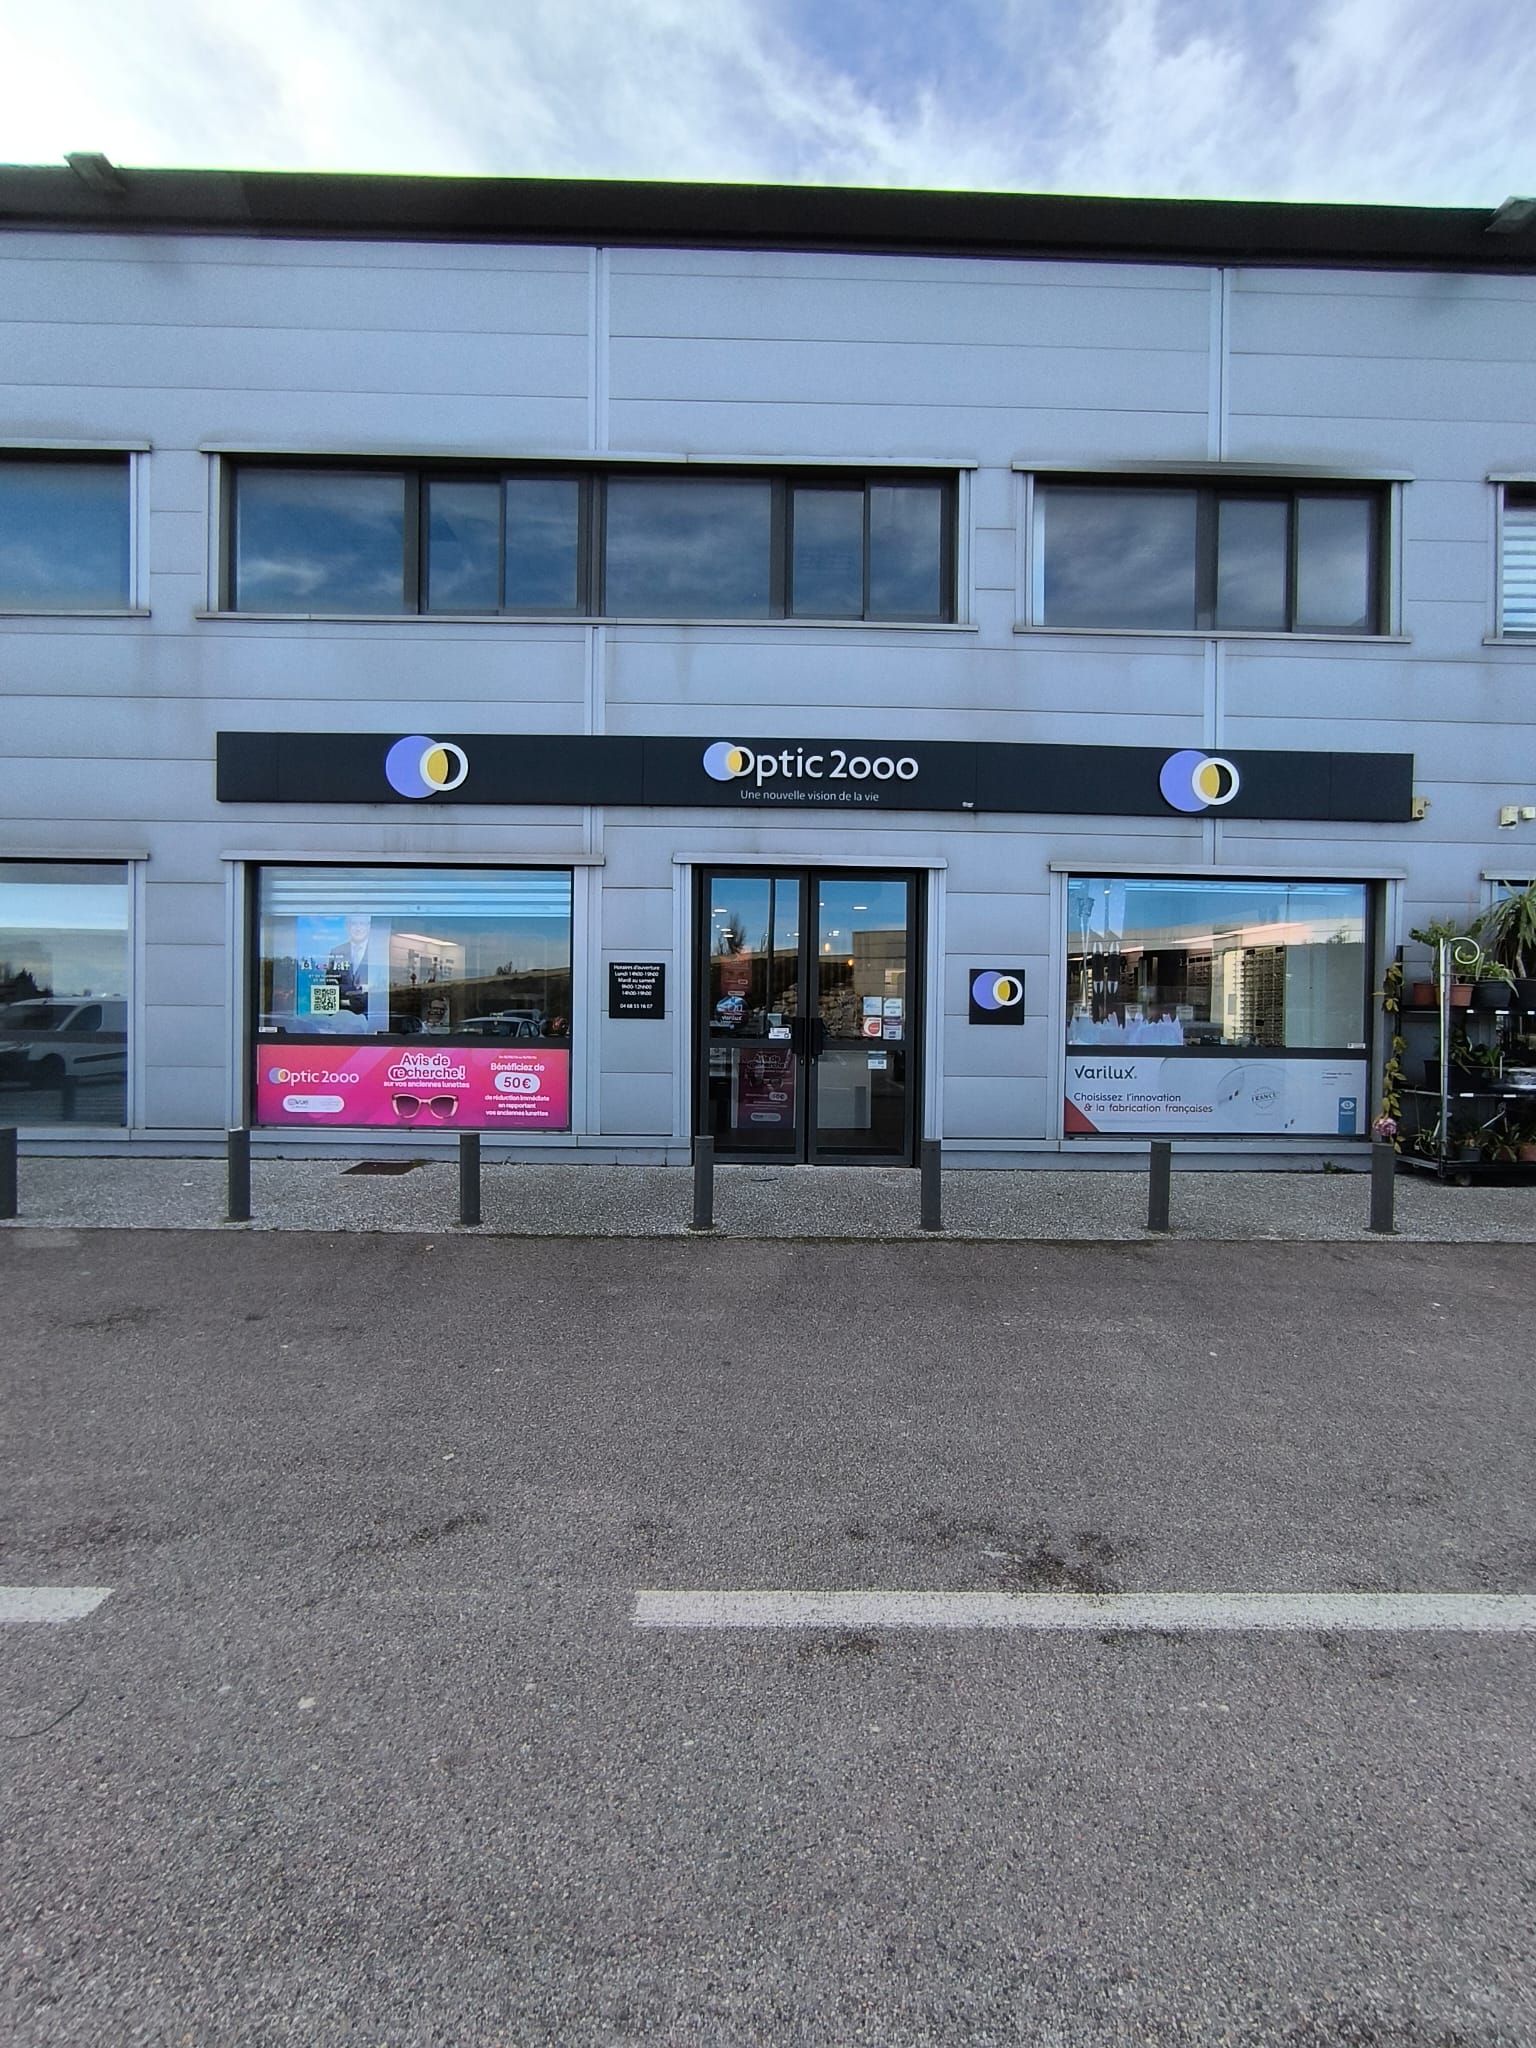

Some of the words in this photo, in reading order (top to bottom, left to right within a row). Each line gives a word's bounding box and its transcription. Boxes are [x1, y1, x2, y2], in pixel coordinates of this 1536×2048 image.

[725, 746, 824, 786] Optic
[829, 750, 918, 780] 2000
[740, 790, 761, 800] Une
[763, 790, 806, 800] nouvelle
[808, 790, 837, 800] vision
[839, 791, 852, 801] de
[854, 792, 862, 801] la
[864, 792, 880, 802] vie
[402, 1054, 430, 1066] Avis
[432, 1054, 449, 1066] de
[490, 1062, 533, 1071] Bénéficiez
[534, 1063, 545, 1072] de
[278, 1069, 320, 1087] Optic
[321, 1070, 360, 1084] 2000
[1074, 1092, 1122, 1101] Choisissez
[1126, 1093, 1181, 1102] l'innovation
[1084, 1103, 1092, 1111] &
[1096, 1103, 1105, 1112] la
[1109, 1103, 1161, 1112] fabrication
[1165, 1104, 1213, 1114] françaises
